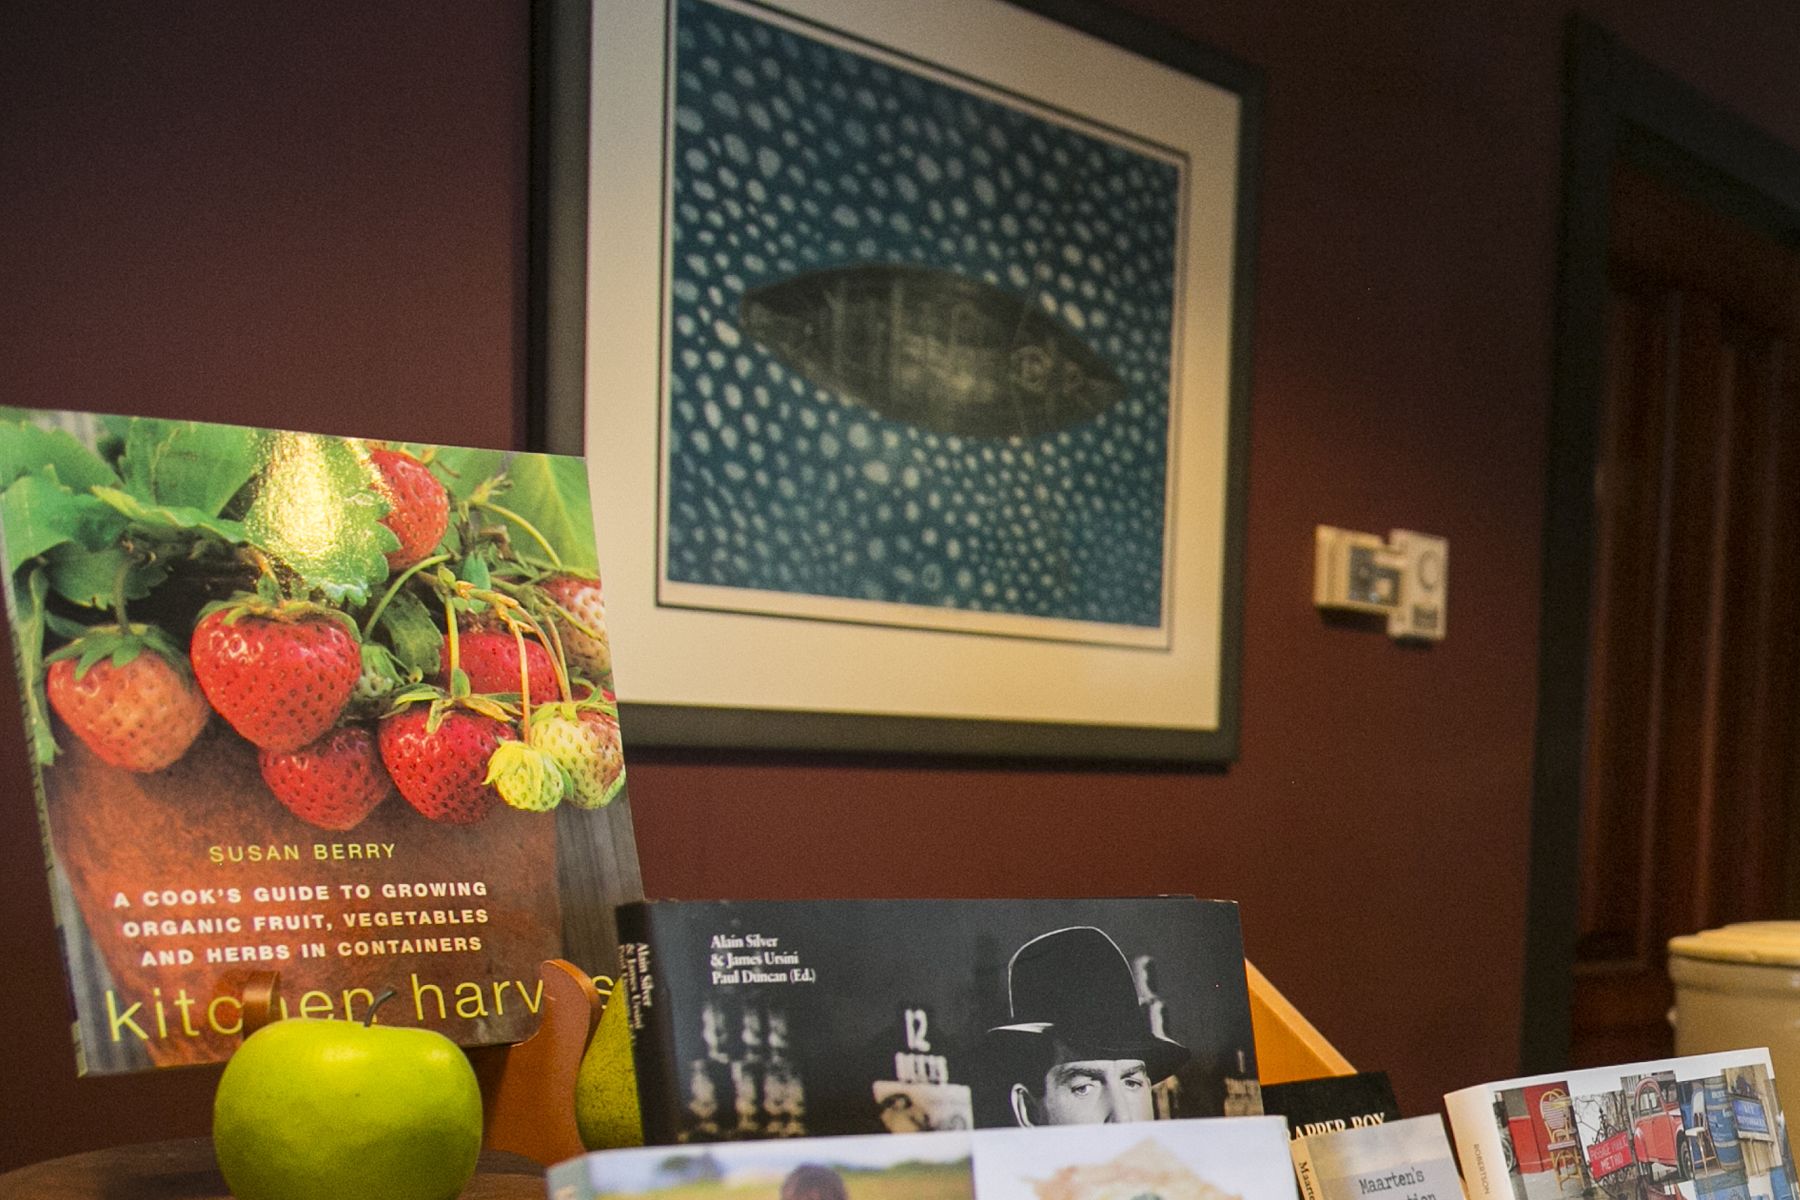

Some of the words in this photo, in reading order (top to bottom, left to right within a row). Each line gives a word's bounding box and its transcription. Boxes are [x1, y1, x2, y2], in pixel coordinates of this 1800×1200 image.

[208, 844, 300, 864] SUSAN
[313, 842, 397, 862] BERRY
[113, 891, 130, 908] A
[142, 886, 242, 907] COOK'S
[253, 884, 330, 904] GUIDE
[340, 884, 371, 901] TO
[381, 881, 488, 900] GROWING
[122, 916, 242, 938] ORGANIC
[253, 913, 333, 933] FRUIT,
[343, 908, 489, 929] VEGETABLES
[141, 948, 195, 967] AND
[206, 944, 290, 964] HERBS
[301, 942, 325, 959] IN
[337, 936, 482, 957] CONTAINERS
[710, 934, 745, 949] Alain
[746, 933, 778, 948] Silver
[636, 941, 652, 973] Alain
[710, 953, 725, 968] &
[726, 952, 763, 968] James
[764, 950, 799, 966] Ursini
[711, 970, 740, 985] Paul
[742, 969, 788, 984] Duncan
[789, 967, 817, 983] (Ed.)
[640, 974, 655, 1007] Silver
[1358, 1167, 1426, 1195] Maarten's
[1472, 1143, 1491, 1195] ROBERTSON
